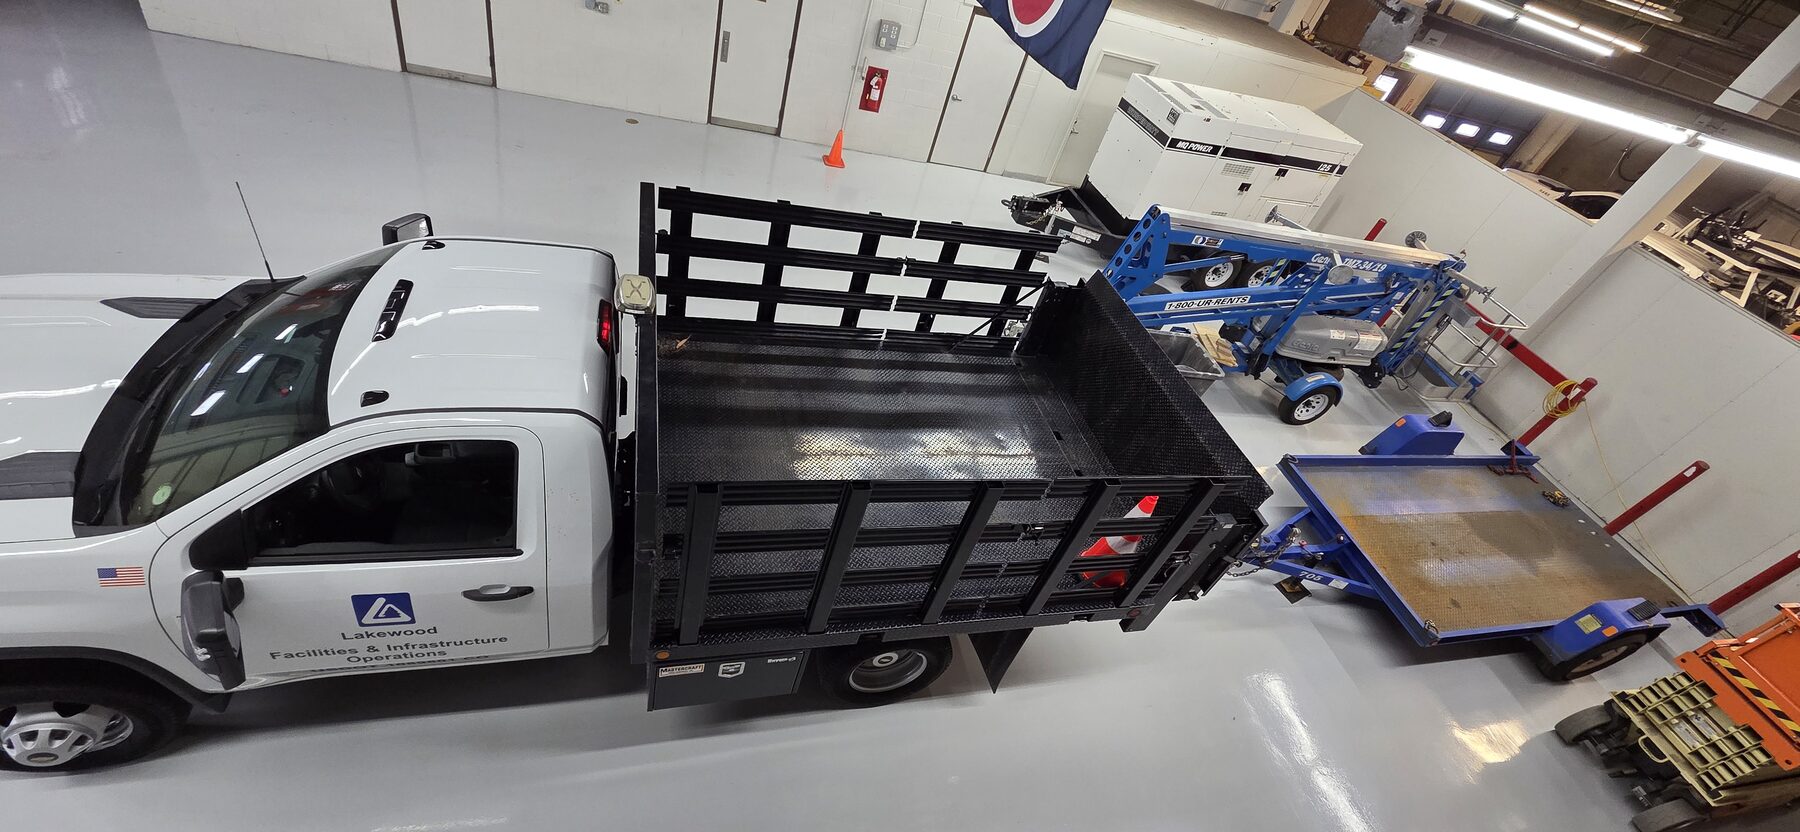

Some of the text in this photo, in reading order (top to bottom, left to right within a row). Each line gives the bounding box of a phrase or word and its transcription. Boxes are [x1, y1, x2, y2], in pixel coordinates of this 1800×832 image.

[1176, 140, 1213, 153] MQ POWER
[1317, 163, 1332, 171] 125
[1343, 257, 1388, 273] TMZ-34/19
[1167, 296, 1248, 310] 1-800-UR-RENTS
[1299, 570, 1324, 581] 705
[341, 626, 438, 640] Lakewood
[269, 635, 509, 660] Facilities & Infrastructure
[346, 649, 448, 663] Operations
